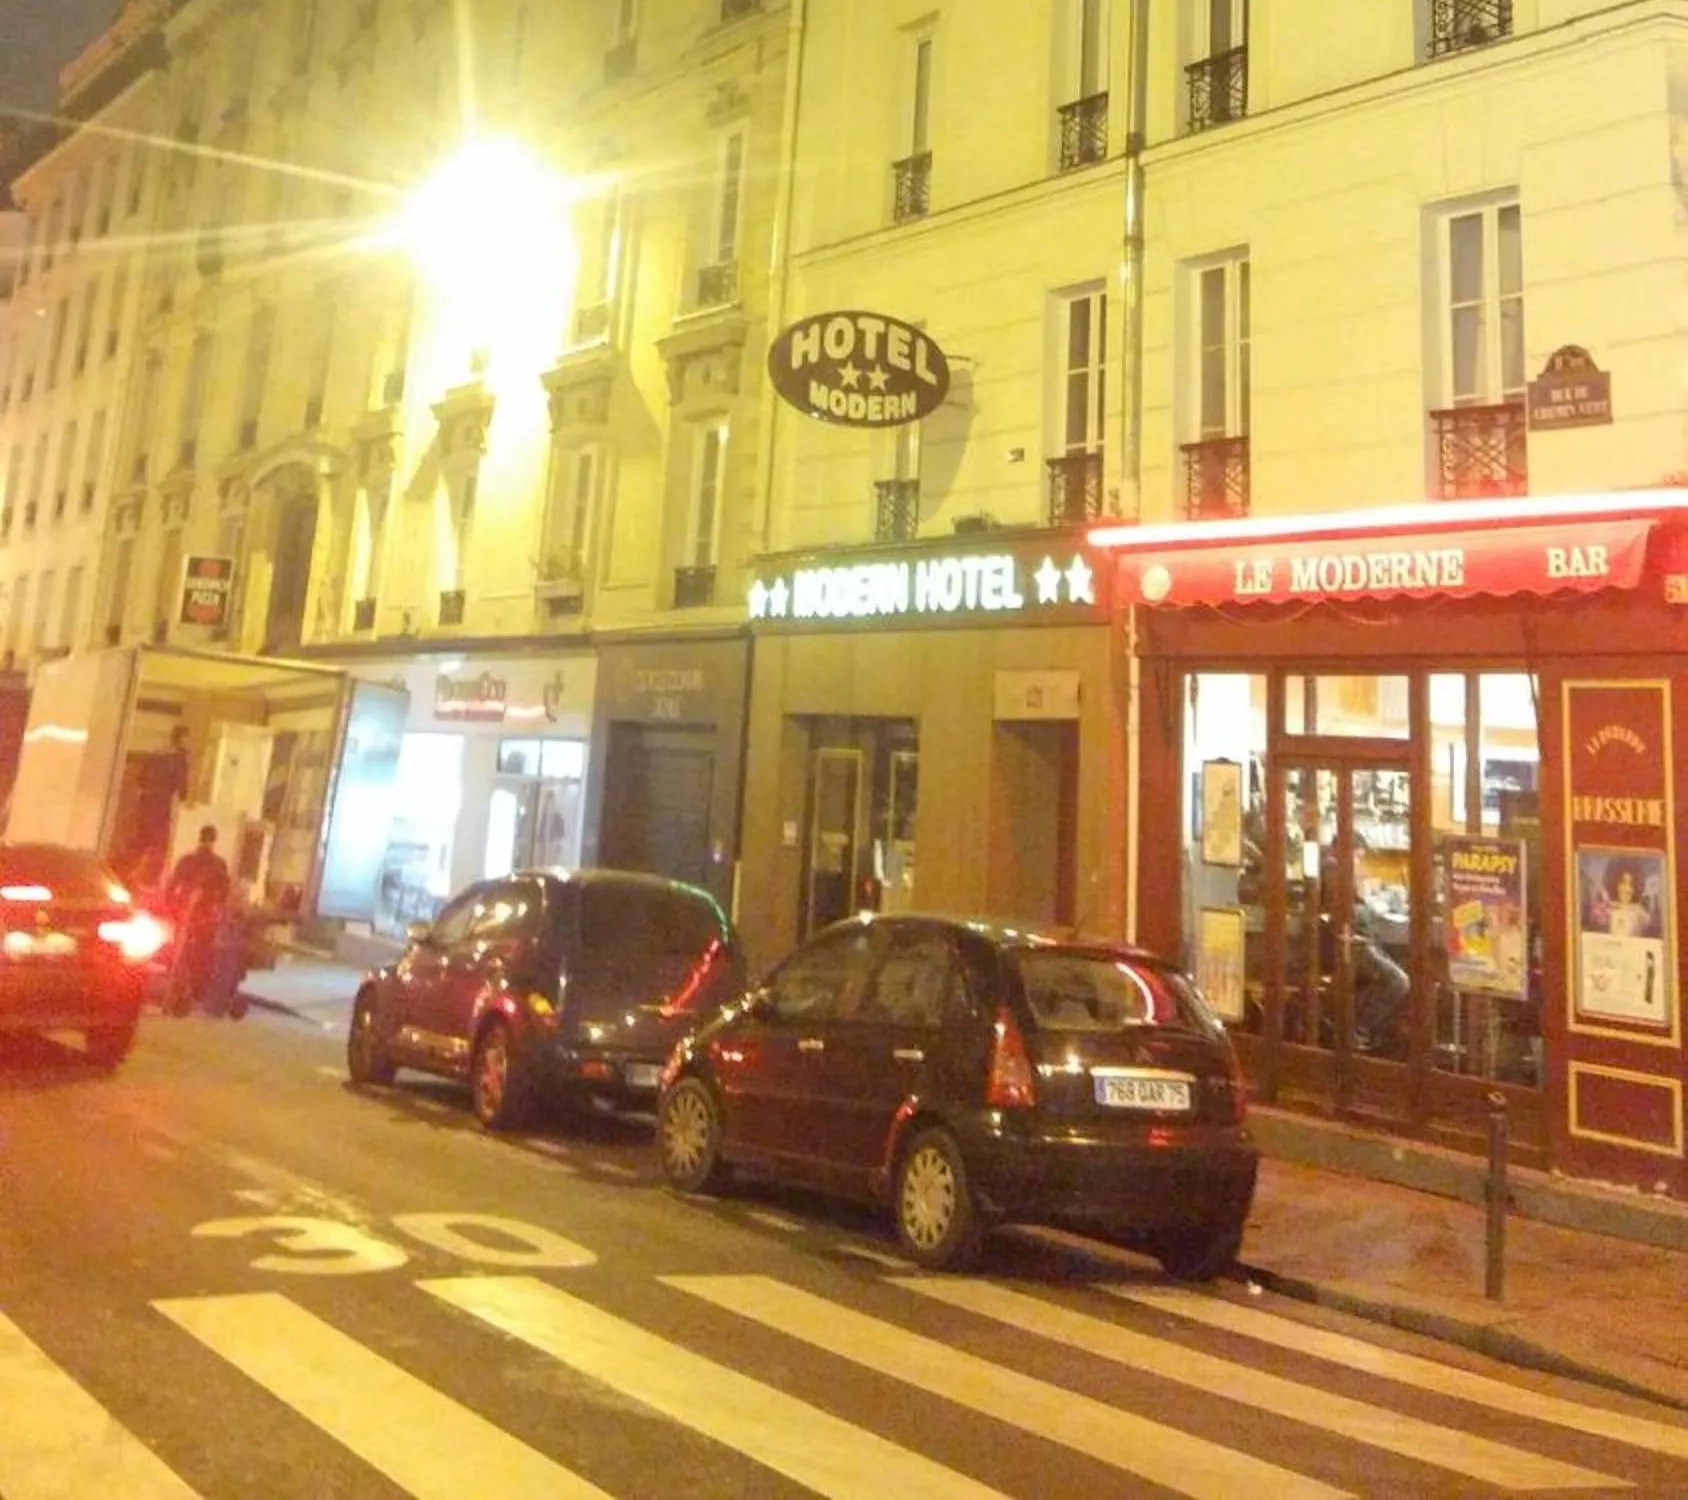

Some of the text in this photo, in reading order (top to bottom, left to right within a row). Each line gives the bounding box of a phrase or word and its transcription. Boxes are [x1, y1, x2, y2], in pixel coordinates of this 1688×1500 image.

[791, 316, 938, 385] HOTEL
[809, 379, 918, 421] MODERN
[793, 554, 1024, 618] MODERN HOTEL
[1234, 545, 1609, 595] LE MODERNE BAR
[191, 1213, 598, 1275] 30
